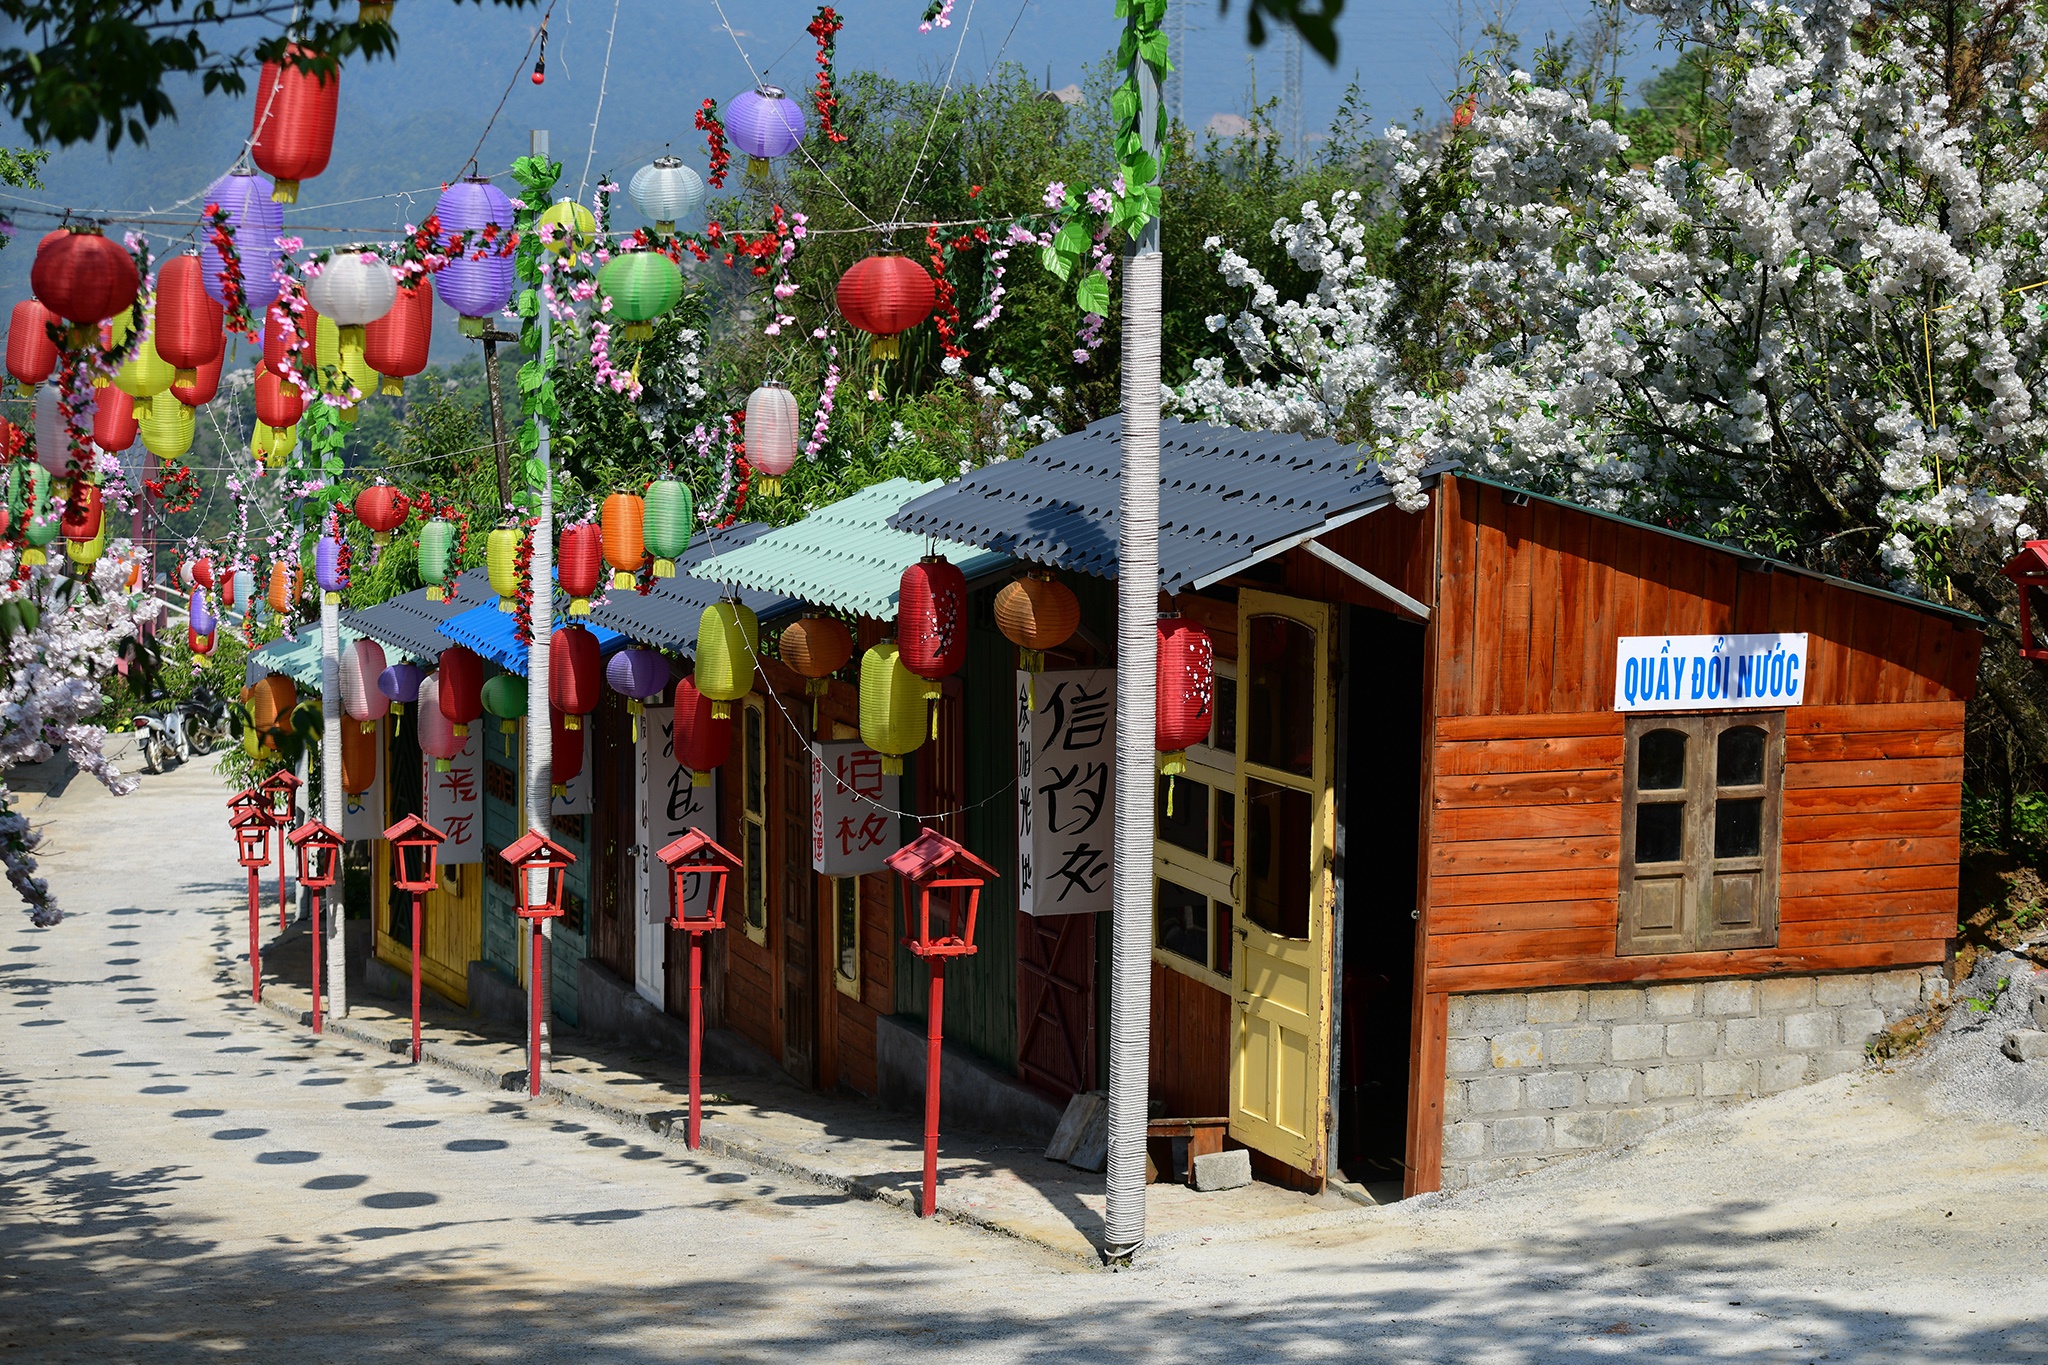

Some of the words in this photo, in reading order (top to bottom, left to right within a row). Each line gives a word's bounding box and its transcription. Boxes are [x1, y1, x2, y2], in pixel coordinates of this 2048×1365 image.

[1624, 640, 1686, 706] QUẦY
[1691, 637, 1730, 700] ĐỔI
[1737, 643, 1799, 698] NƯỚC
